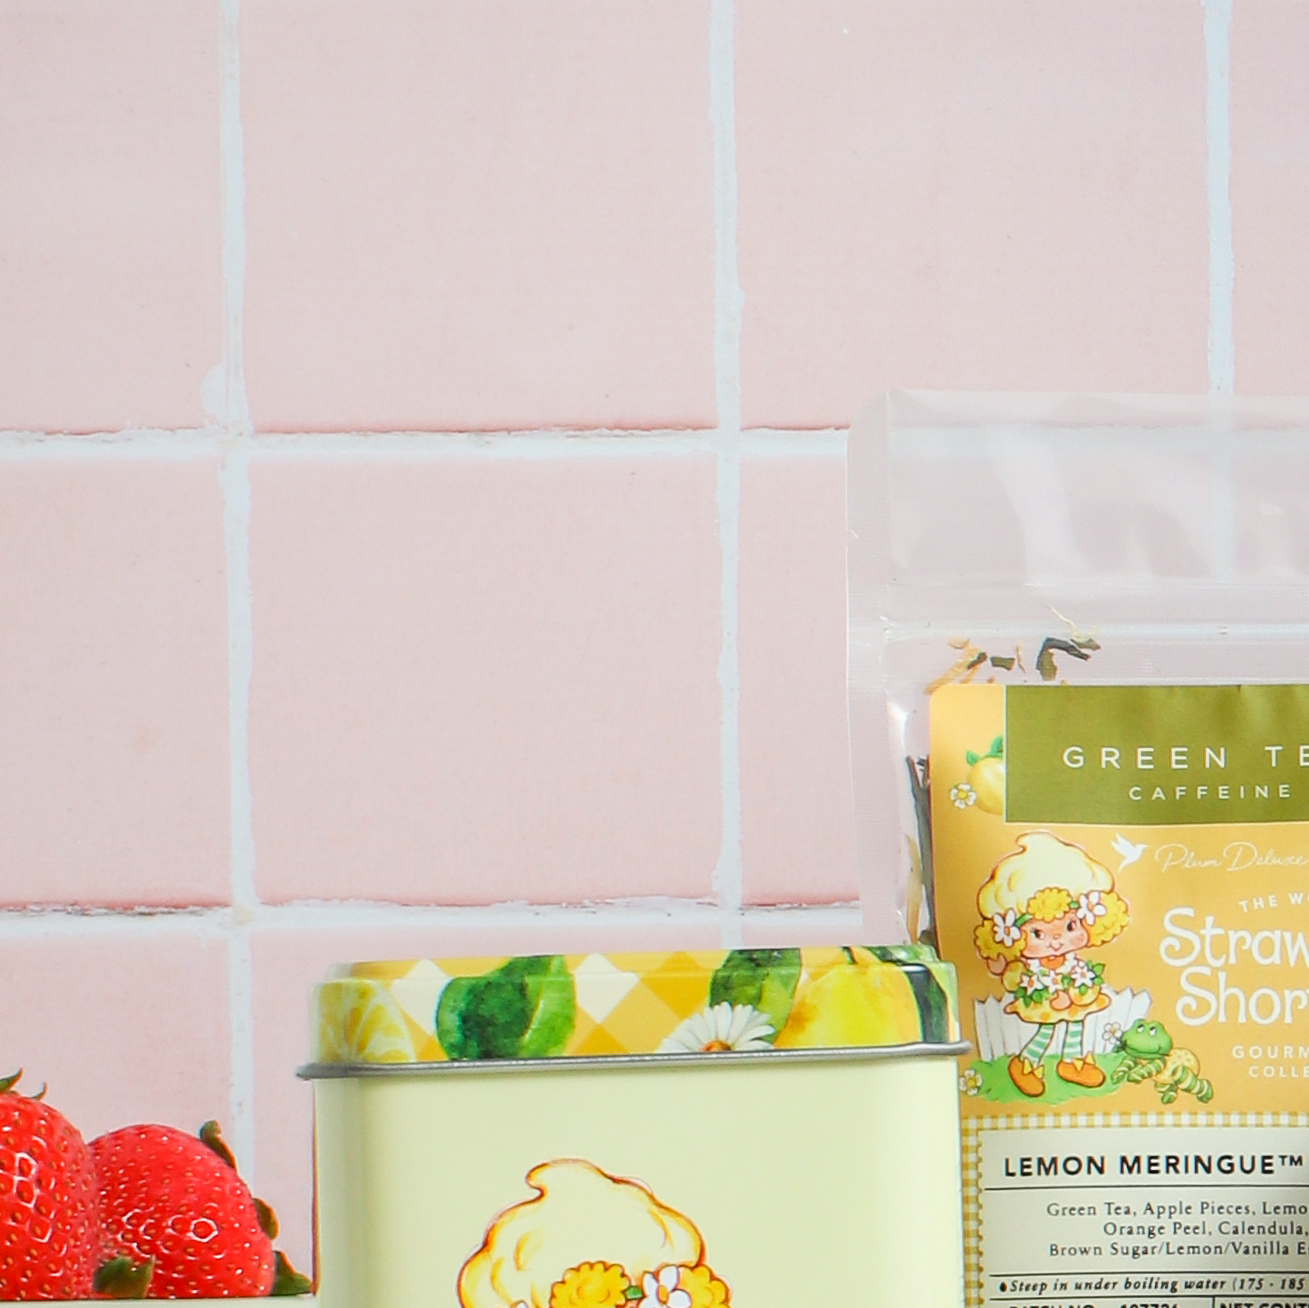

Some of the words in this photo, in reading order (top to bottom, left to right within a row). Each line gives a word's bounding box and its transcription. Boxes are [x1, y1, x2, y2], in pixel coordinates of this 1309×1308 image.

[1063, 746, 1226, 770] GREEN
[1129, 784, 1292, 800] CAFFEINE
[1155, 843, 1221, 873] Plum
[1222, 842, 1309, 872] Deluxe
[1239, 898, 1278, 913] THE
[1005, 1155, 1106, 1177] LEMON
[1047, 1203, 1096, 1216] Green
[1104, 1202, 1137, 1216] Tea,
[1143, 1202, 1192, 1219] Apple
[1200, 1202, 1257, 1216] Pieces,
[1103, 1223, 1165, 1239] Orange
[1173, 1222, 1212, 1236] Peel,
[1218, 1222, 1309, 1236] Calendula,
[1050, 1244, 1102, 1256] Brown
[1110, 1242, 1289, 1259] Sugar/Lemon/Vanilla
[1010, 1280, 1048, 1295] Steep
[1054, 1280, 1068, 1291] in
[1074, 1279, 1118, 1291] under
[1125, 1277, 1178, 1293] boiling
[1185, 1279, 1227, 1289] water
[1232, 1277, 1264, 1291] (175
[1280, 1277, 1304, 1290] 185
